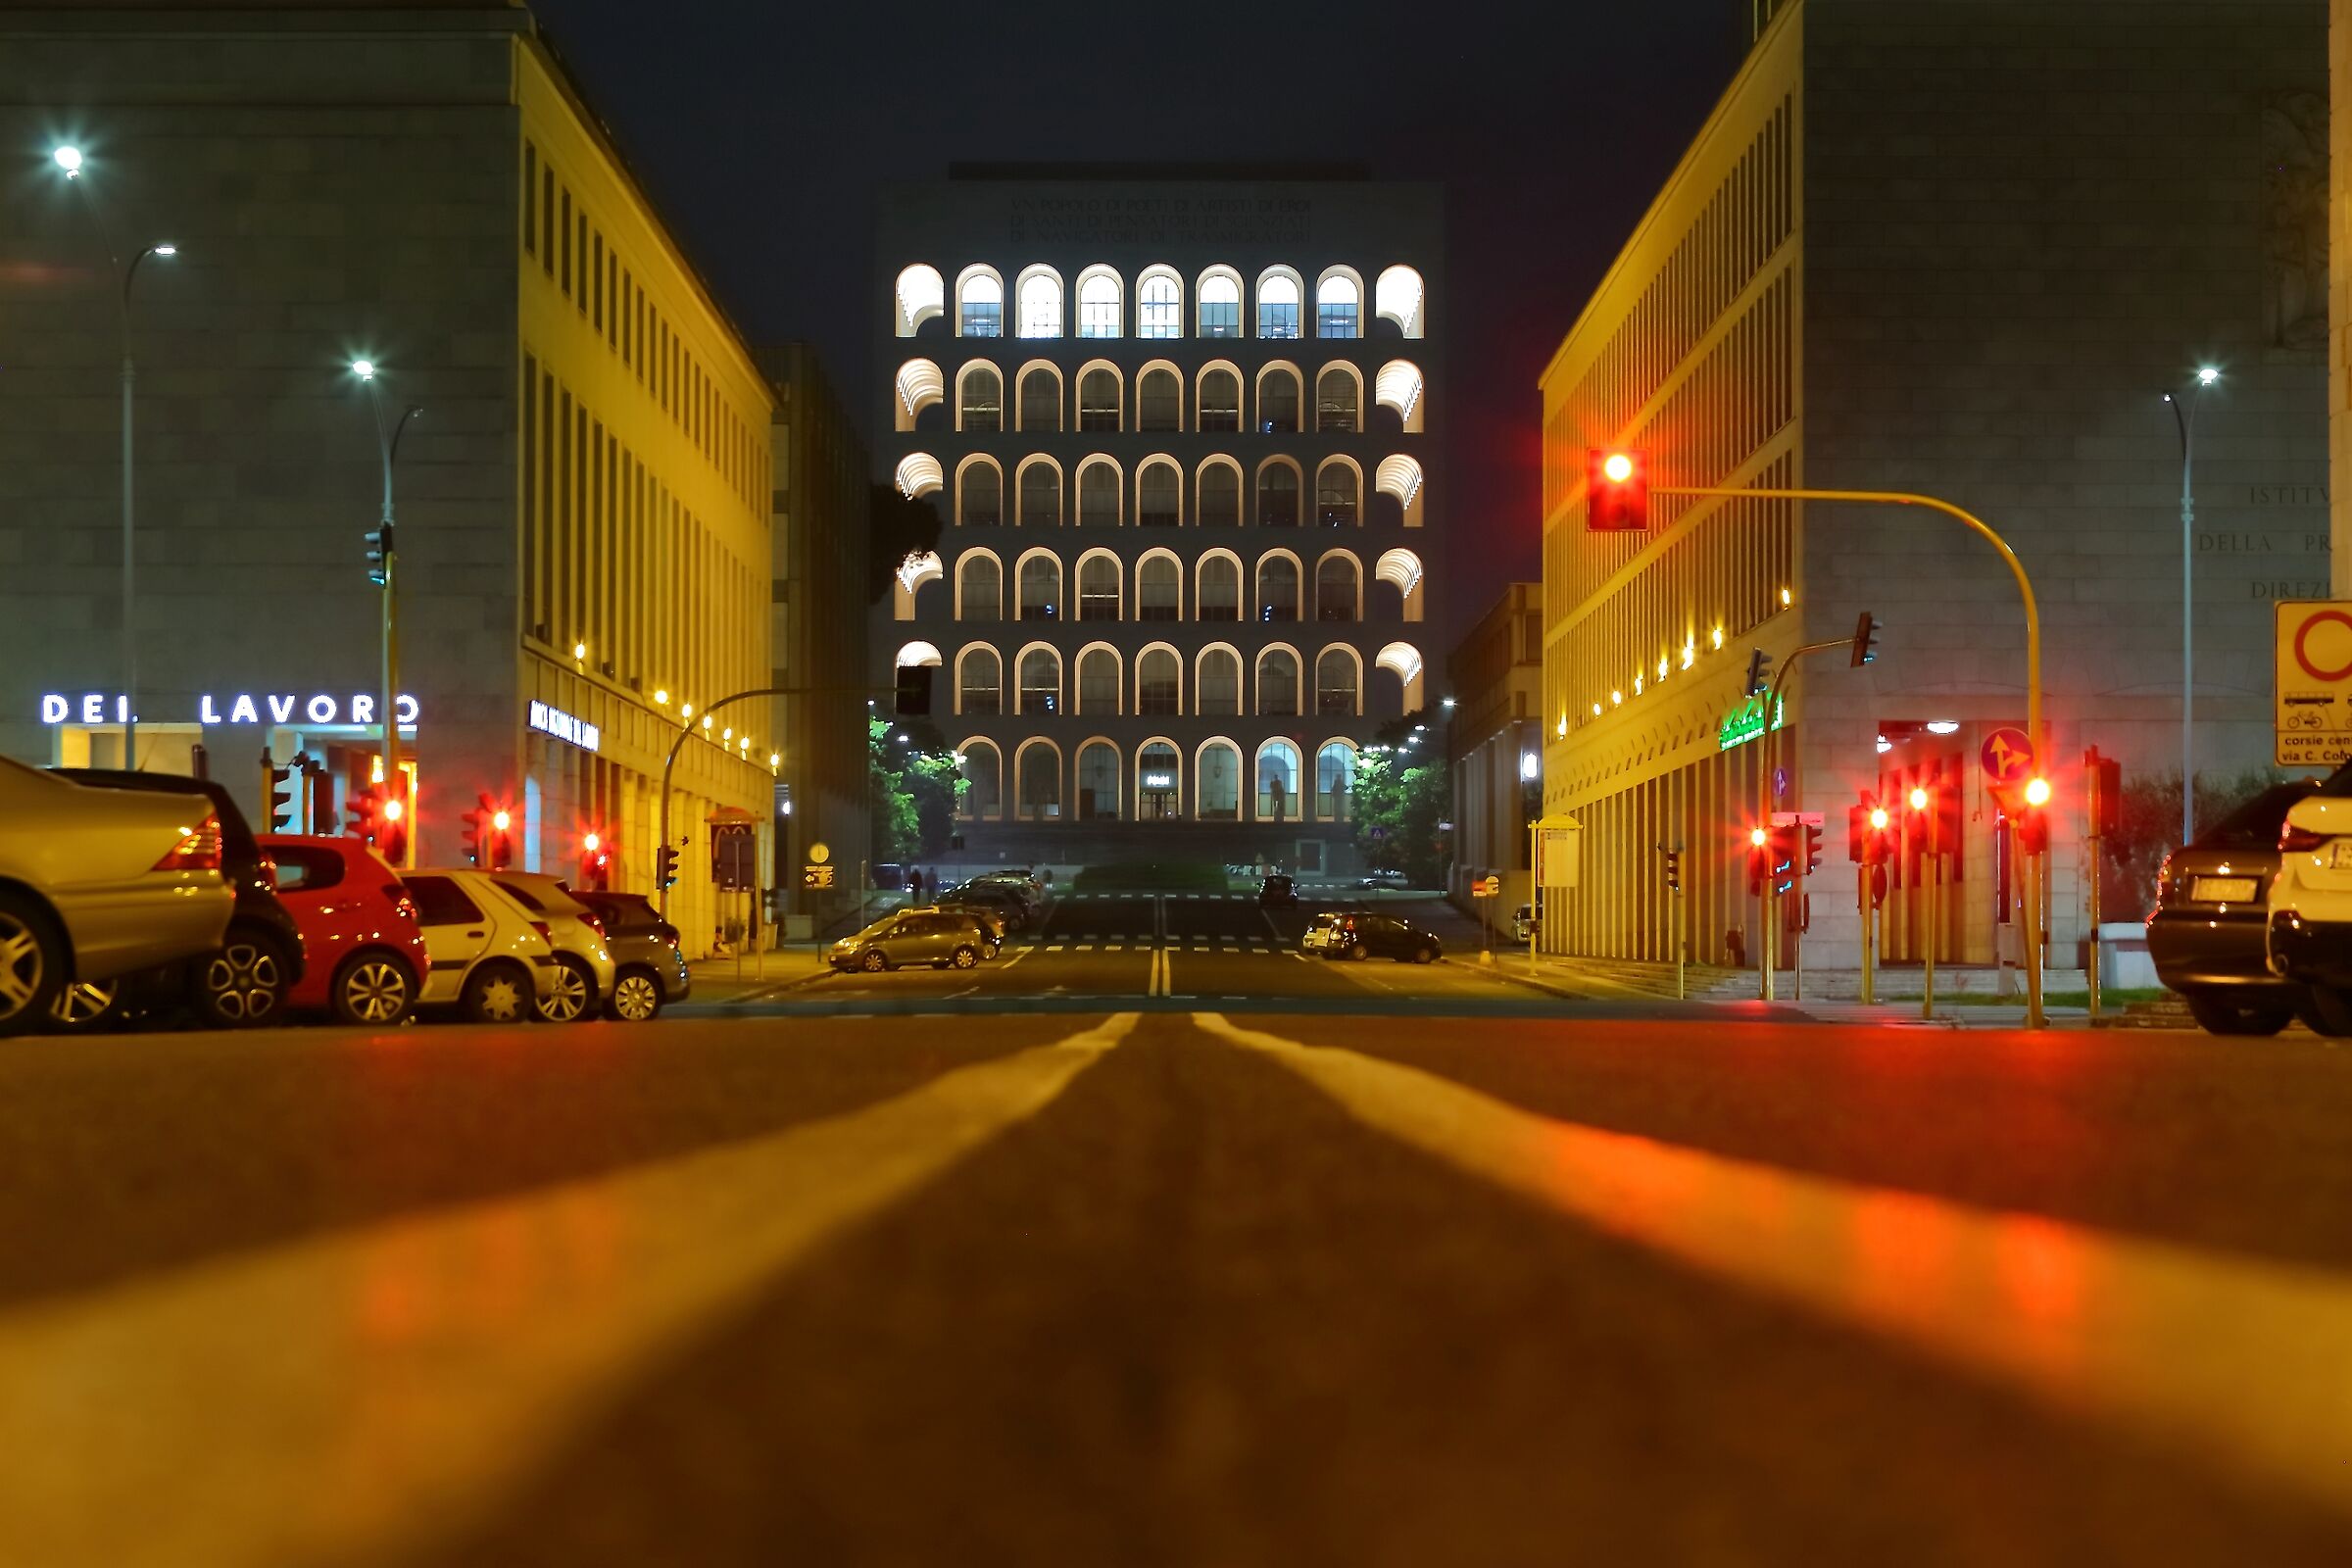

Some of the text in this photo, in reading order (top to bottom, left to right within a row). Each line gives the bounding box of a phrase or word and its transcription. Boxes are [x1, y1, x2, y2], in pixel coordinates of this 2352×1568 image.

[2199, 534, 2331, 552] DELLA PR
[2251, 581, 2330, 600] DIREZI
[201, 693, 419, 724] LAVORO
[2285, 735, 2352, 746] corsie cen
[2282, 750, 2300, 760] via
